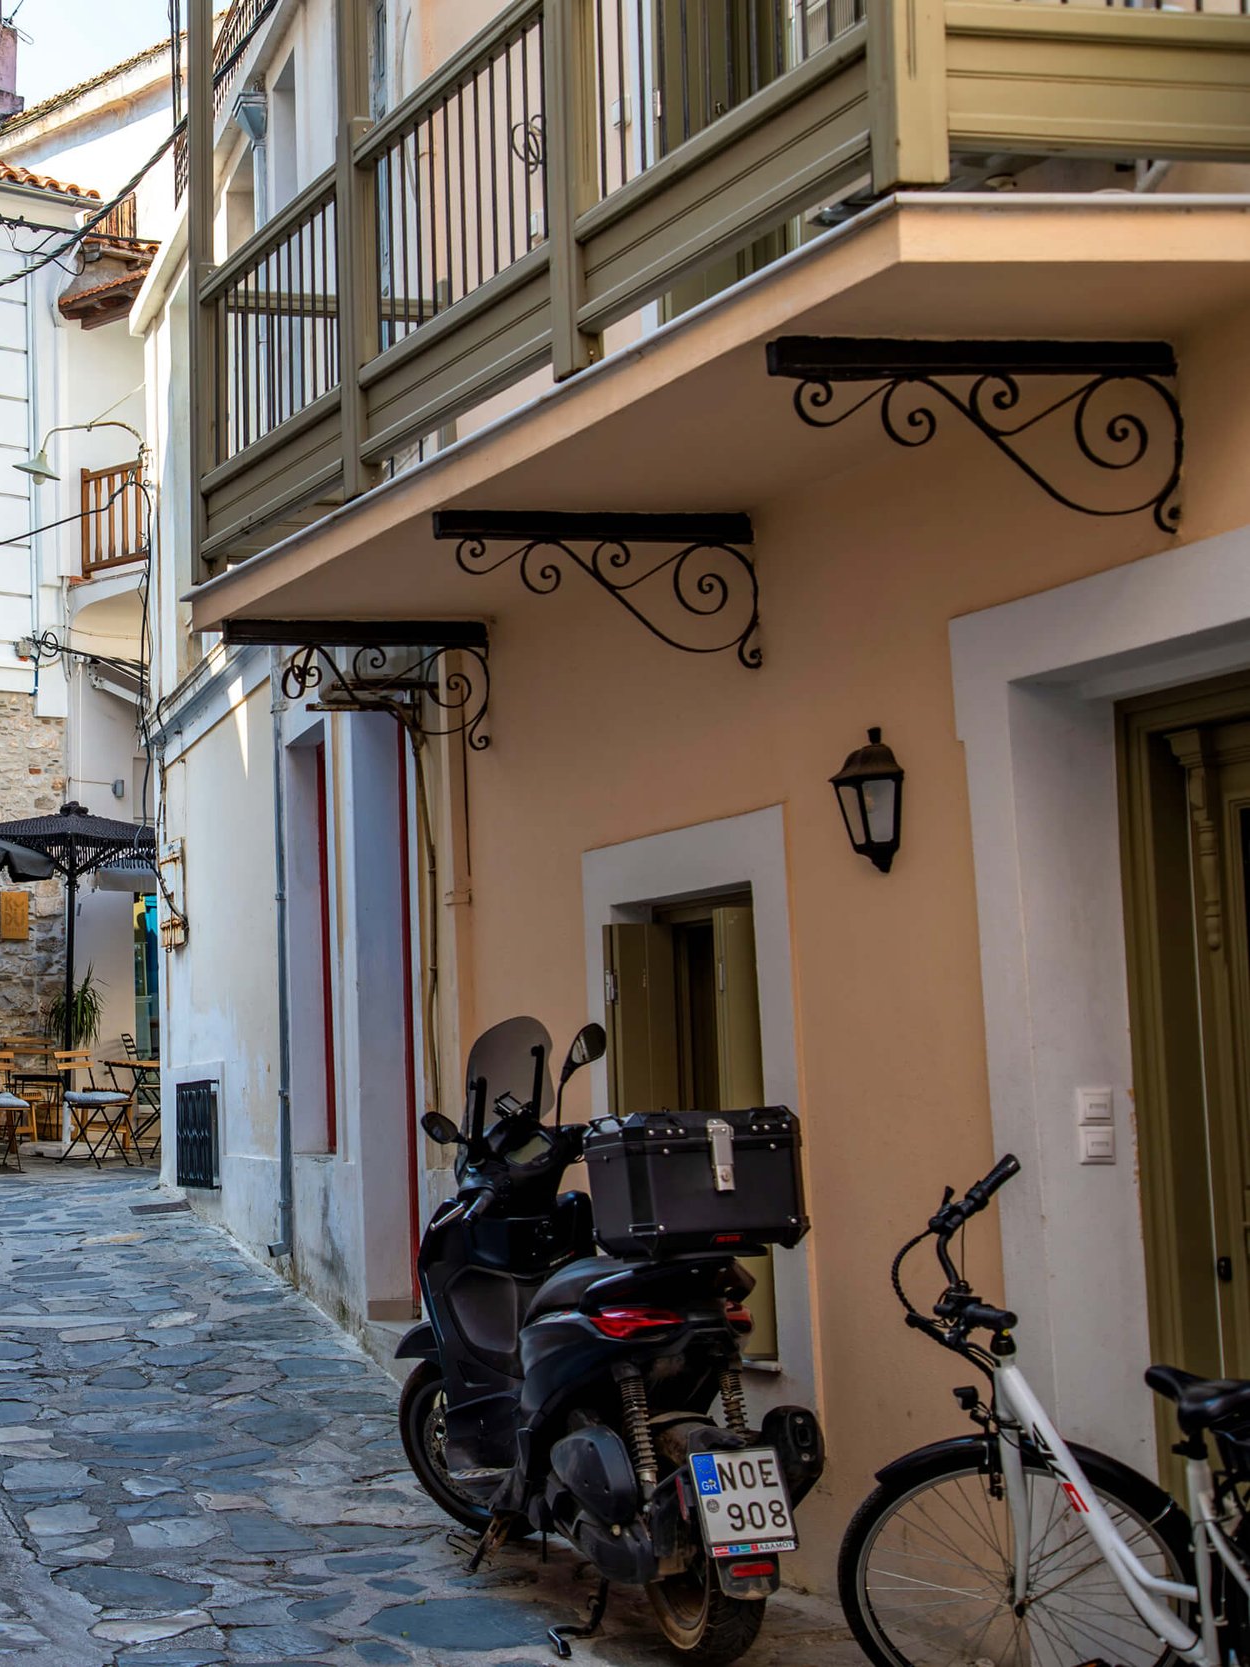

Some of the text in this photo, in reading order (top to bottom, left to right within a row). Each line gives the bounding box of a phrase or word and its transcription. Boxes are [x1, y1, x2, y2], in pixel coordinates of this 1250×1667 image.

[701, 1479, 718, 1491] GR
[717, 1458, 779, 1491] NOE
[727, 1500, 787, 1532] 908
